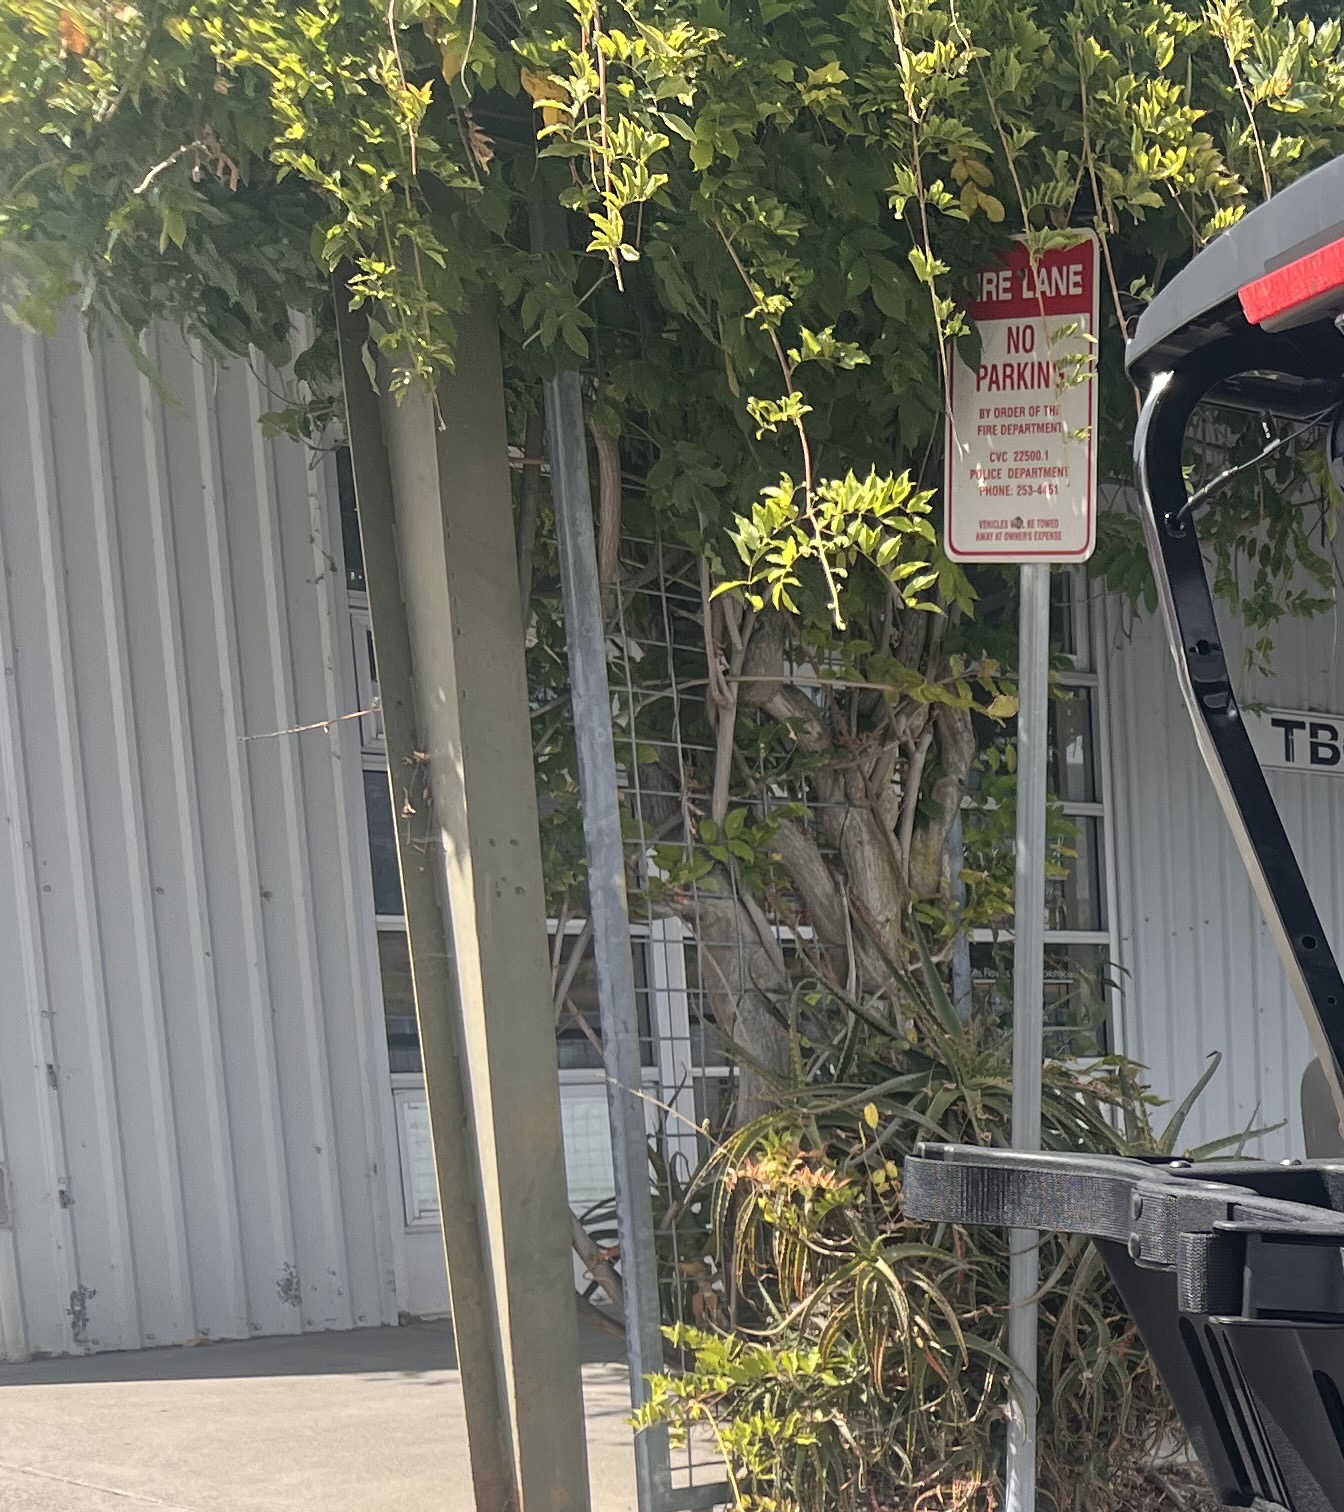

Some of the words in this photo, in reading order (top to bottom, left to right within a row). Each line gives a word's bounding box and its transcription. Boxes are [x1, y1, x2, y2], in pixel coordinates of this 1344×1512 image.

[1022, 264, 1083, 300] LANE
[1007, 323, 1036, 355] NO
[978, 407, 991, 420] BY
[993, 406, 1026, 419] ORDER
[1028, 405, 1041, 418] OF
[977, 424, 998, 437] FIRE
[1000, 421, 1063, 436] DEPARTMENT
[989, 451, 1008, 463] CVC
[1013, 449, 1049, 461] 22500.1
[969, 468, 1002, 481] POLICE
[1007, 465, 1070, 480] DEPARTMENT
[979, 485, 1014, 497] PHONE:
